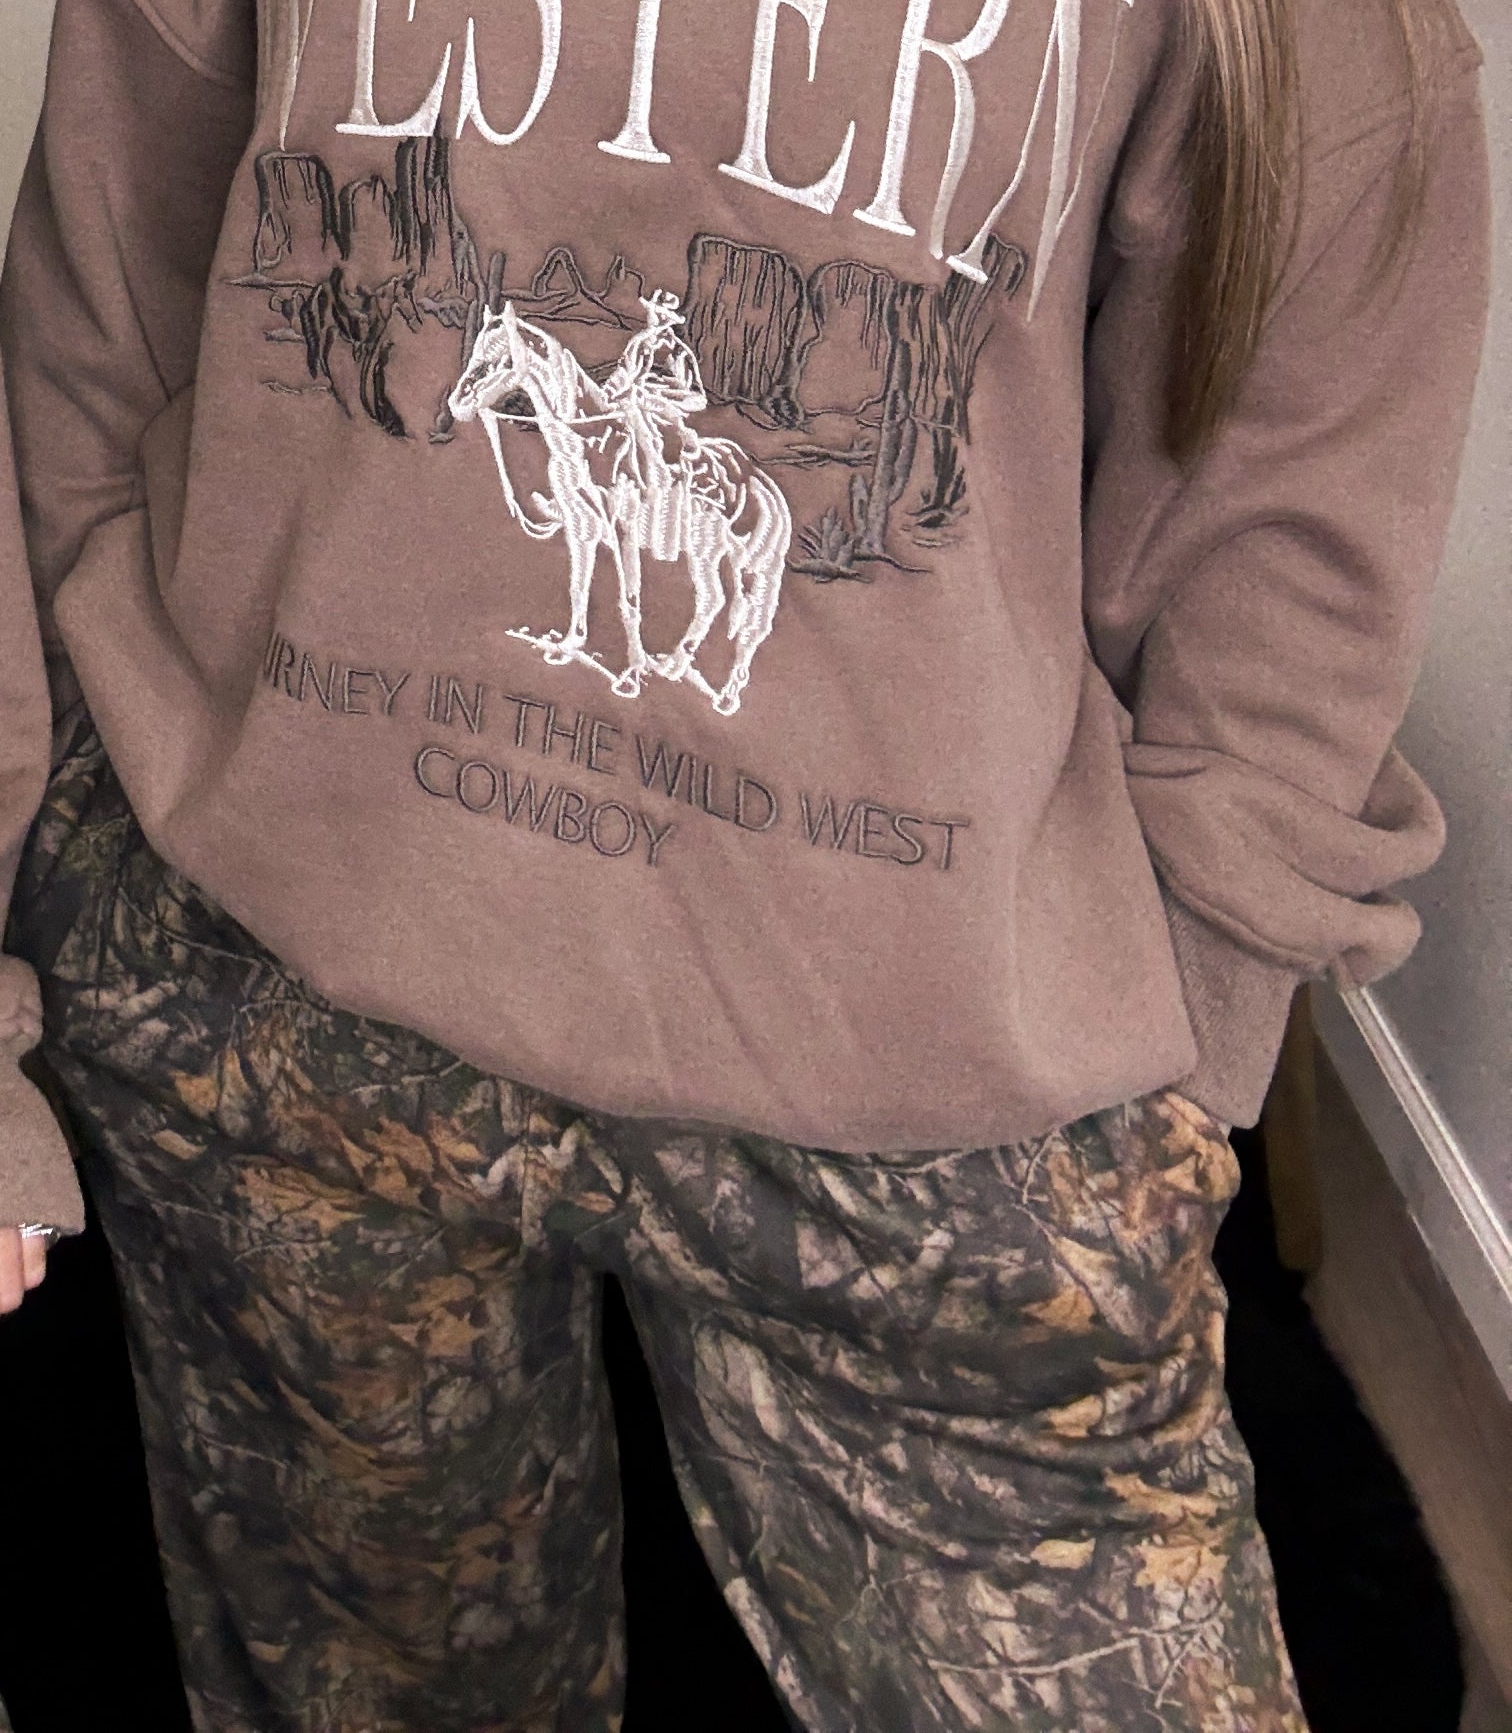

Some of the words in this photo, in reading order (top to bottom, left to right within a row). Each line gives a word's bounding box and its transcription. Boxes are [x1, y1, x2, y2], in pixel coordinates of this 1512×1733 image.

[414, 745, 675, 868] COWBOY
[426, 674, 485, 736] IN
[502, 692, 620, 775] THE
[635, 732, 779, 833] WILD
[799, 792, 971, 870] WEST
